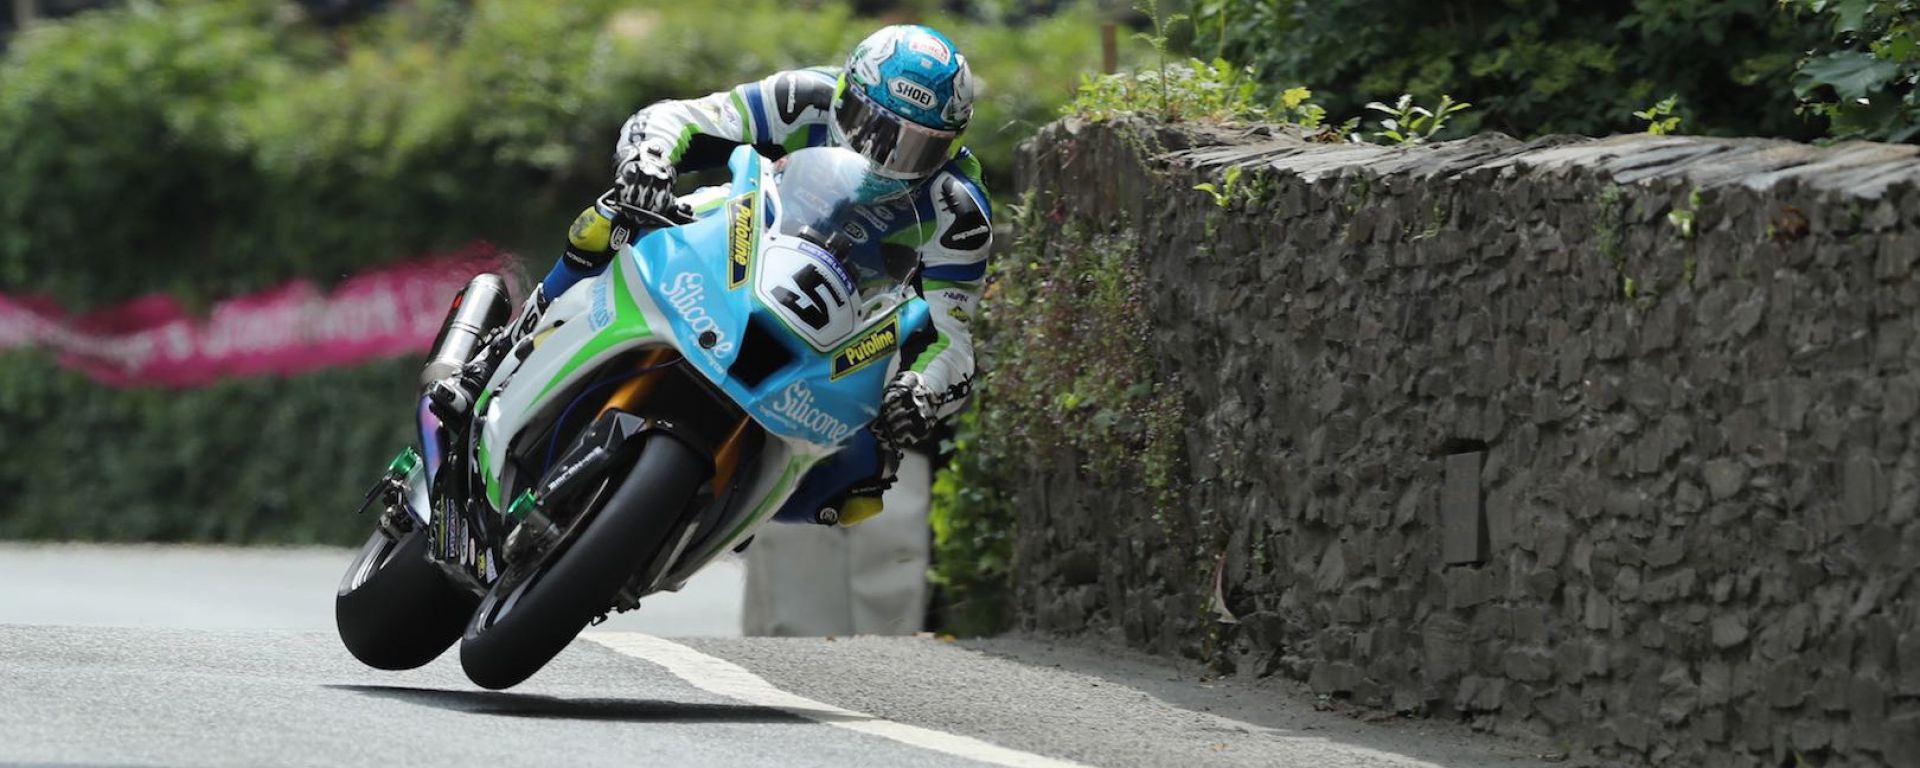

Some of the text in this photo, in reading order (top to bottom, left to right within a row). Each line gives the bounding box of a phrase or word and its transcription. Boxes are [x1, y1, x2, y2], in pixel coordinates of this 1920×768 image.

[895, 81, 932, 106] SHOEI
[734, 203, 752, 266] Putoline
[659, 271, 733, 359] Silicone
[769, 263, 845, 331] 5
[844, 329, 894, 365] Putoline
[773, 378, 848, 440] Silicone
